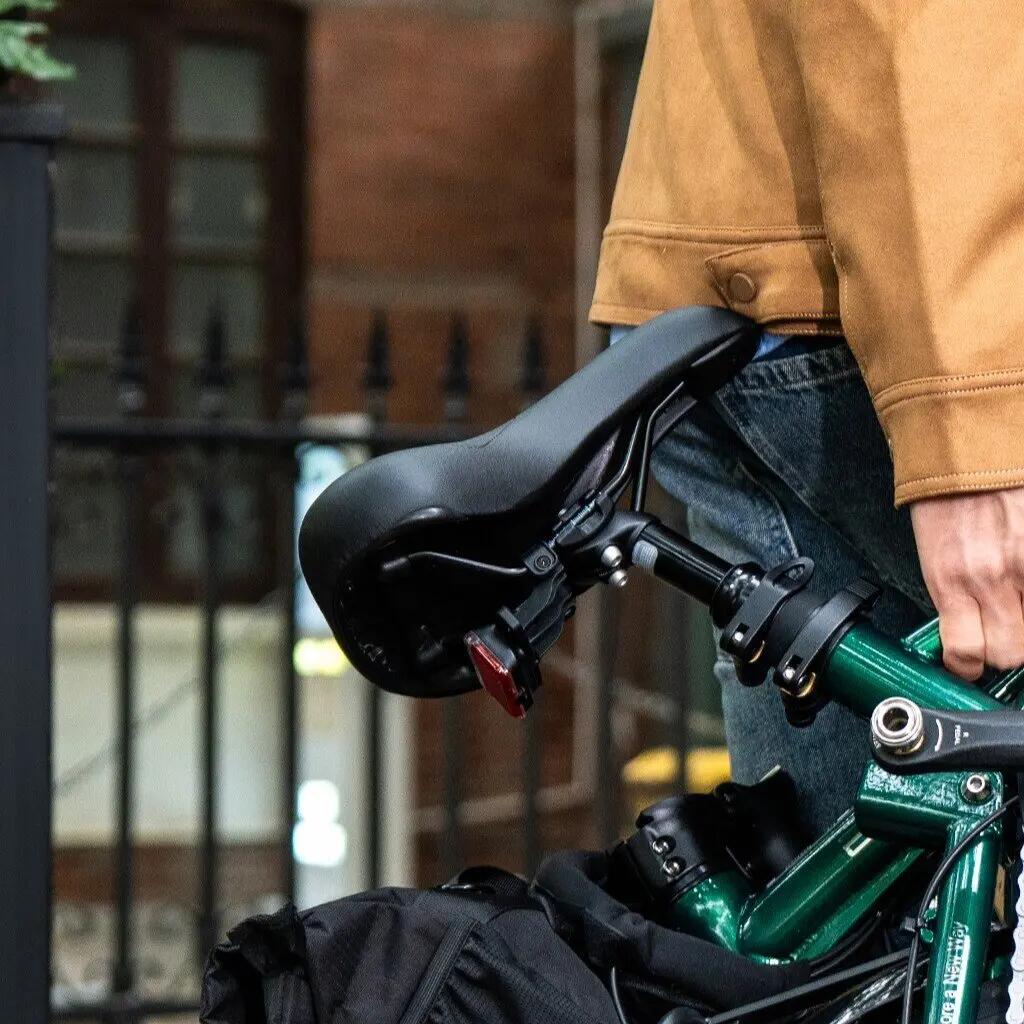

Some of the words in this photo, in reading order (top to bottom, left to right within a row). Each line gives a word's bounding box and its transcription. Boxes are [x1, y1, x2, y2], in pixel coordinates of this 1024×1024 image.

[947, 920, 969, 953] Way
[943, 954, 963, 986] New
[944, 989, 957, 1000] a
